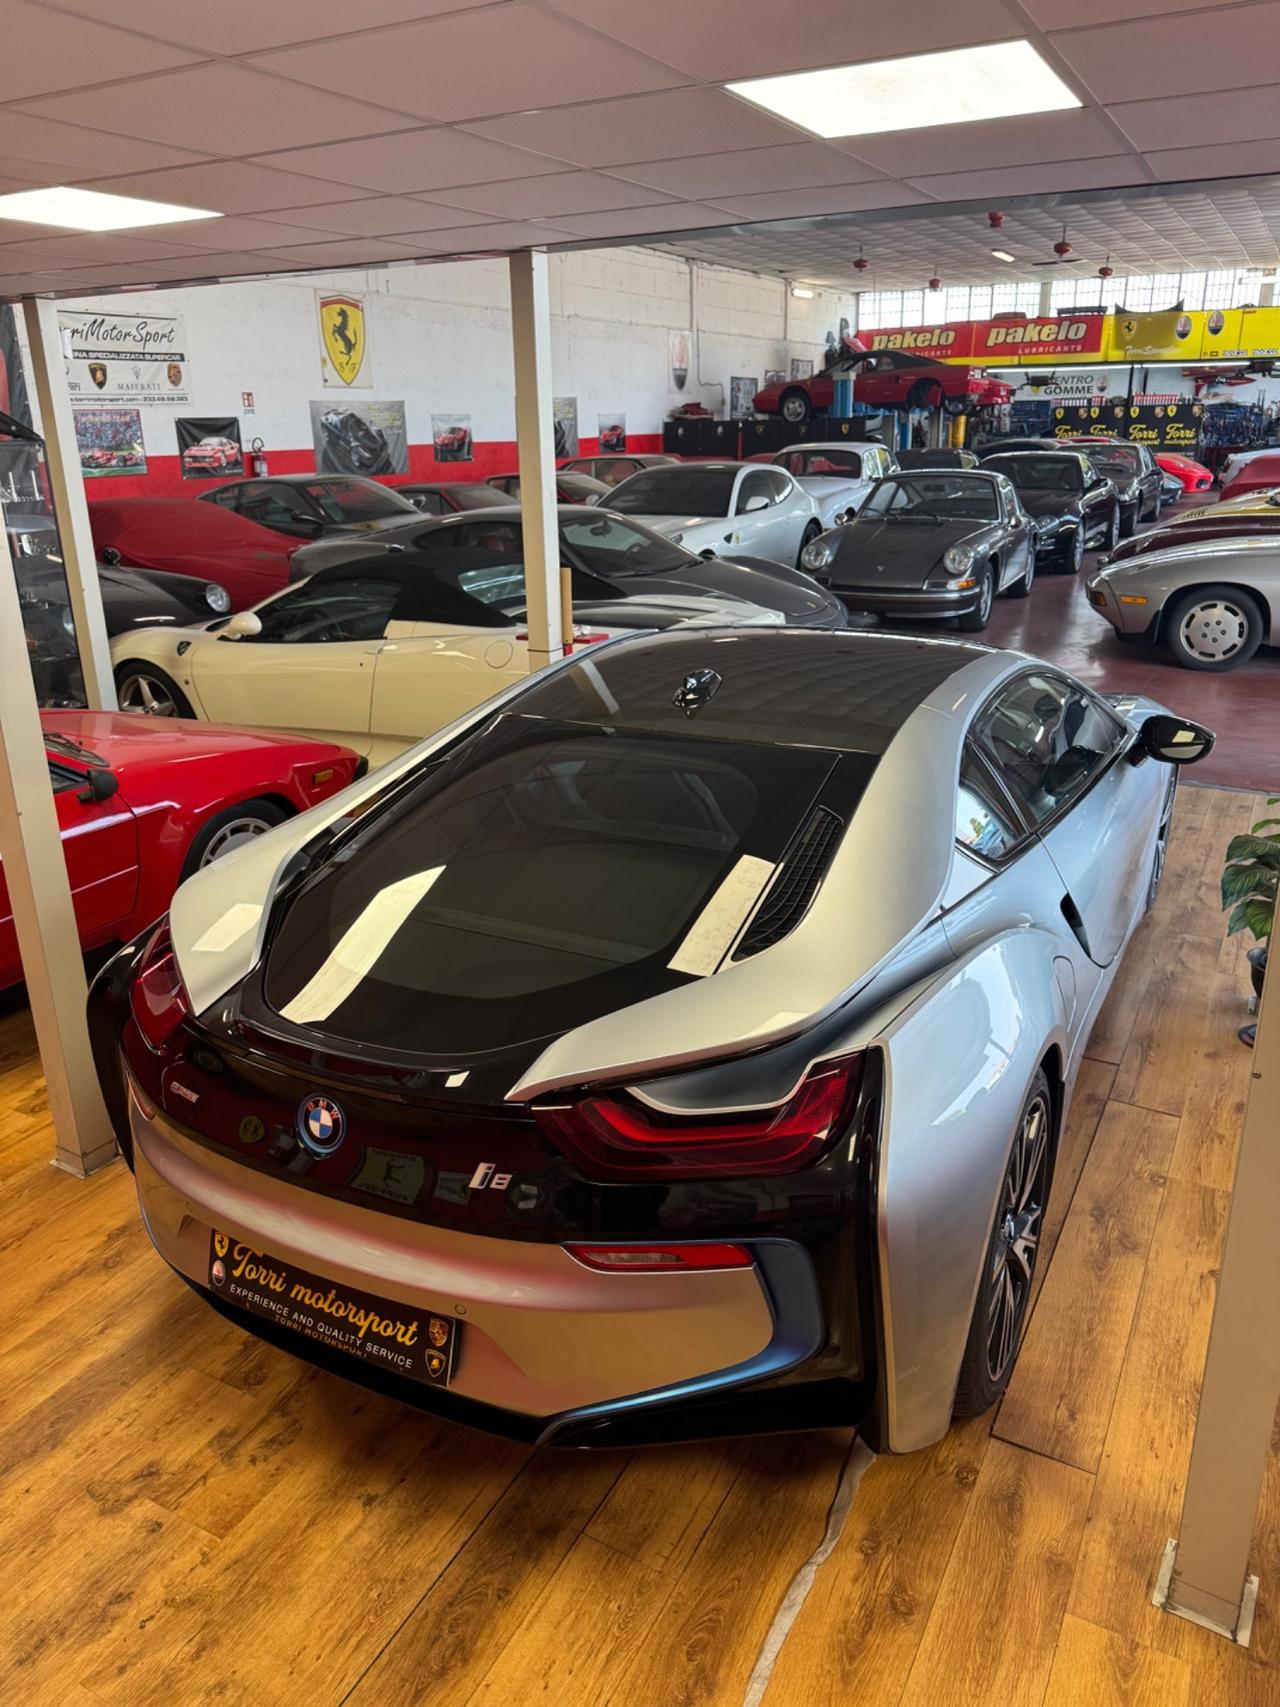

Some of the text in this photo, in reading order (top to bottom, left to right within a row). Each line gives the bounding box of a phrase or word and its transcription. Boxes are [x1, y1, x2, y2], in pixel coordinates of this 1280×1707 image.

[872, 328, 956, 350] pakelo
[987, 321, 1088, 347] pakelo
[1018, 344, 1082, 354] LUBRICANTS
[116, 383, 161, 391] MASERATI
[1054, 375, 1094, 385] ENTRO
[1044, 385, 1093, 396] GOMME
[1129, 424, 1159, 440] Torri
[1166, 423, 1196, 439] Torri
[468, 1162, 513, 1190] i8
[231, 1241, 419, 1346] Torri motorsport
[230, 1284, 413, 1369] EXPERIENCE AND QUALITY SERVICE
[274, 1314, 302, 1332] TORRI
